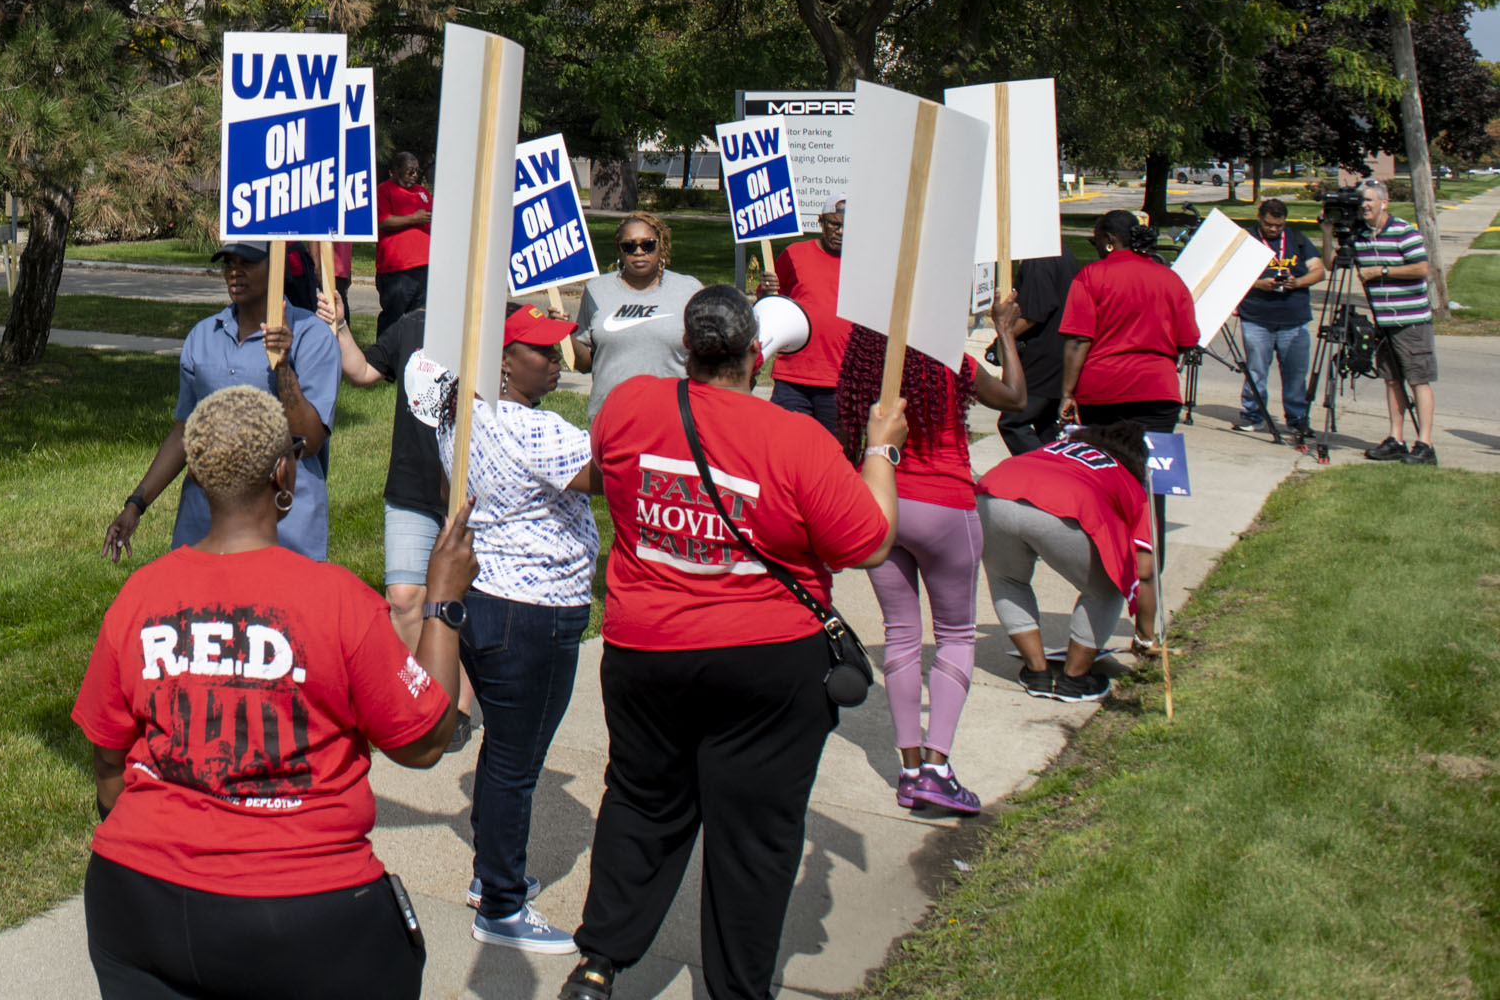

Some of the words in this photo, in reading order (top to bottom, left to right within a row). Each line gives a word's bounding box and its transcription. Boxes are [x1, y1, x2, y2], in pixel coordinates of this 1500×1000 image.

[232, 53, 338, 100] UAW
[767, 101, 855, 114] MOPAR
[265, 117, 306, 170] ON
[721, 127, 779, 161] UAW
[802, 128, 832, 137] Parking
[808, 141, 834, 149] Center
[514, 148, 560, 192] AW
[791, 154, 815, 164] kaging
[231, 157, 335, 228] STRIKE
[746, 166, 771, 200] ON
[802, 176, 823, 184] Parts
[825, 176, 848, 185] Divisi
[809, 187, 830, 196] Parts
[521, 197, 554, 240] ON
[736, 187, 793, 236] STRIKE
[511, 218, 584, 285] STRIKE
[614, 304, 658, 318] NIKE
[637, 526, 749, 565] PART
[140, 621, 306, 683] R.E.D.
[245, 797, 302, 809] DEPLOYED
